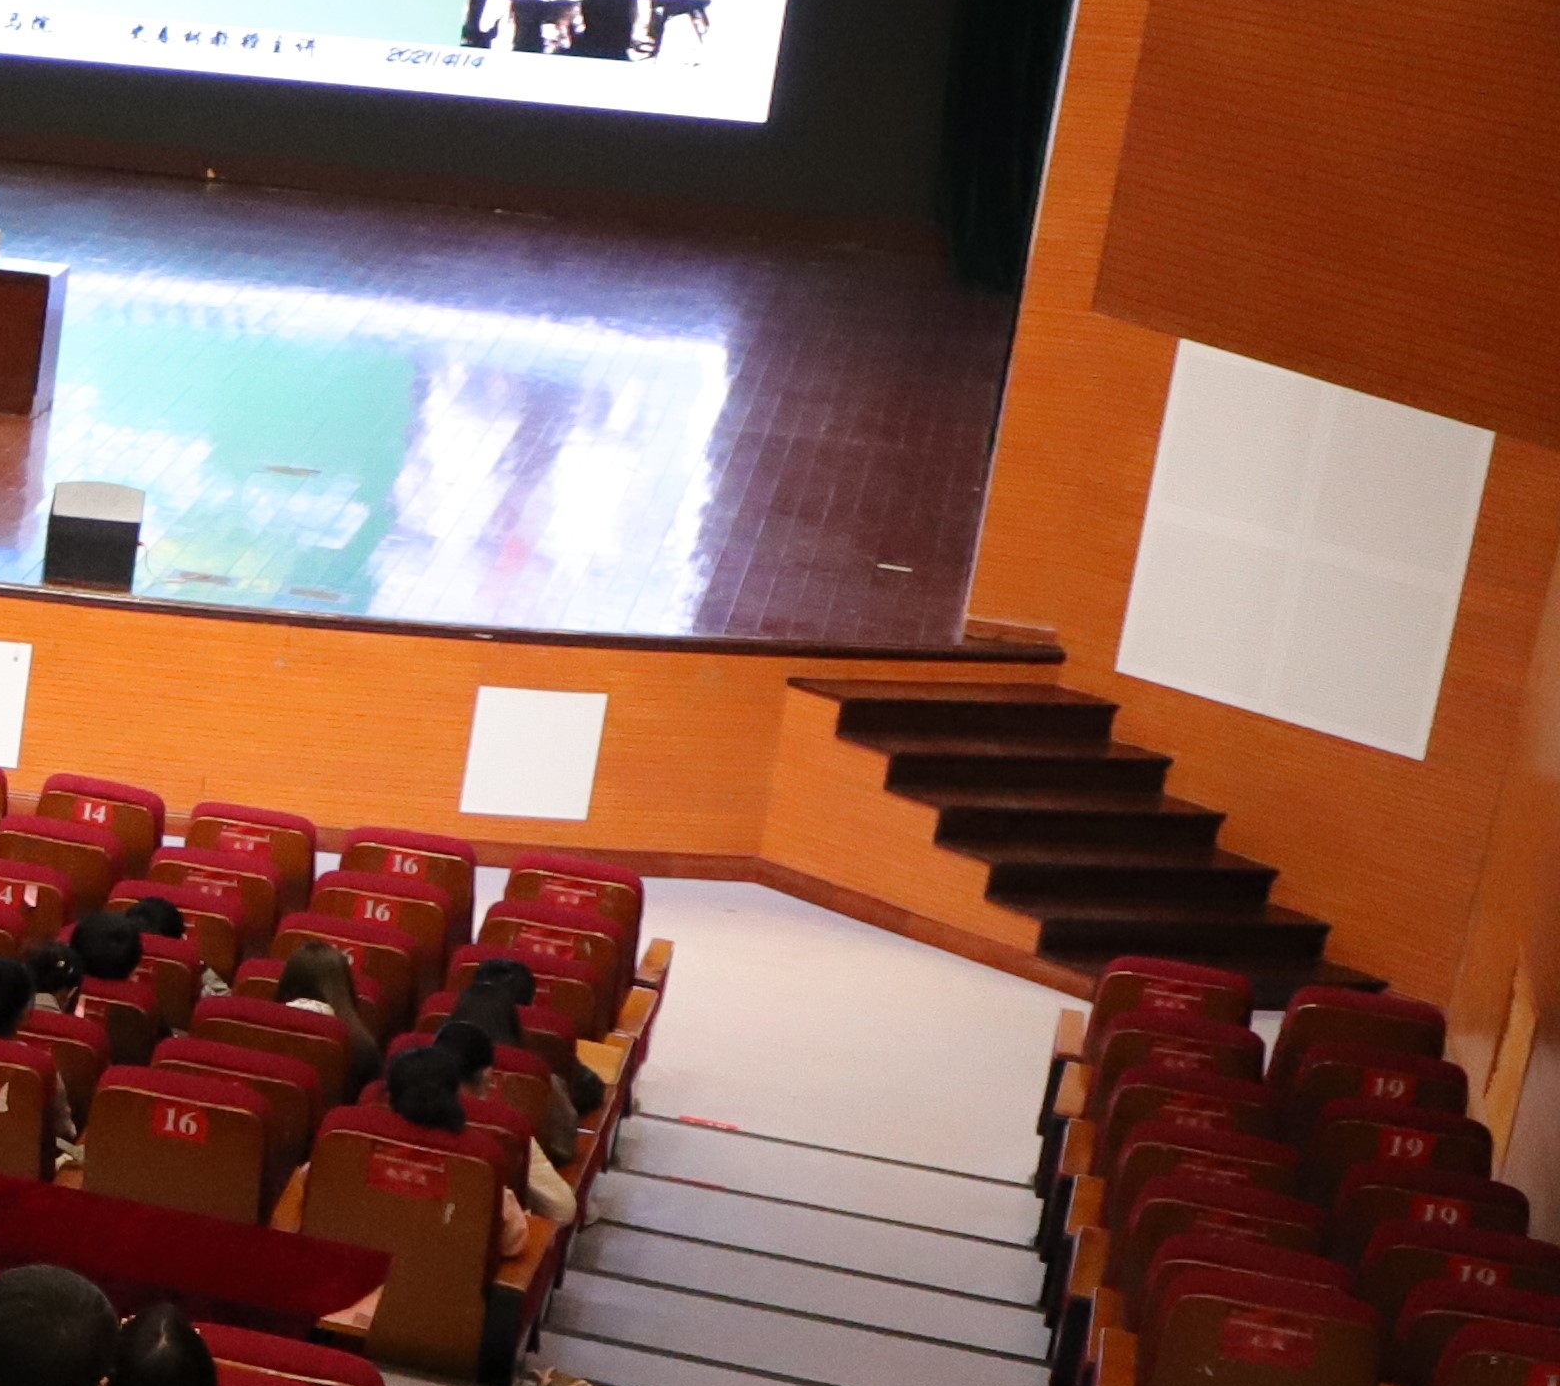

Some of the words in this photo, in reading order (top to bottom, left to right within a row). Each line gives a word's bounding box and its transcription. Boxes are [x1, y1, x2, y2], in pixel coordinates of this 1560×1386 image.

[81, 803, 106, 823] 14
[392, 854, 418, 874] 16
[364, 900, 390, 920] 16
[164, 1110, 198, 1133] 16
